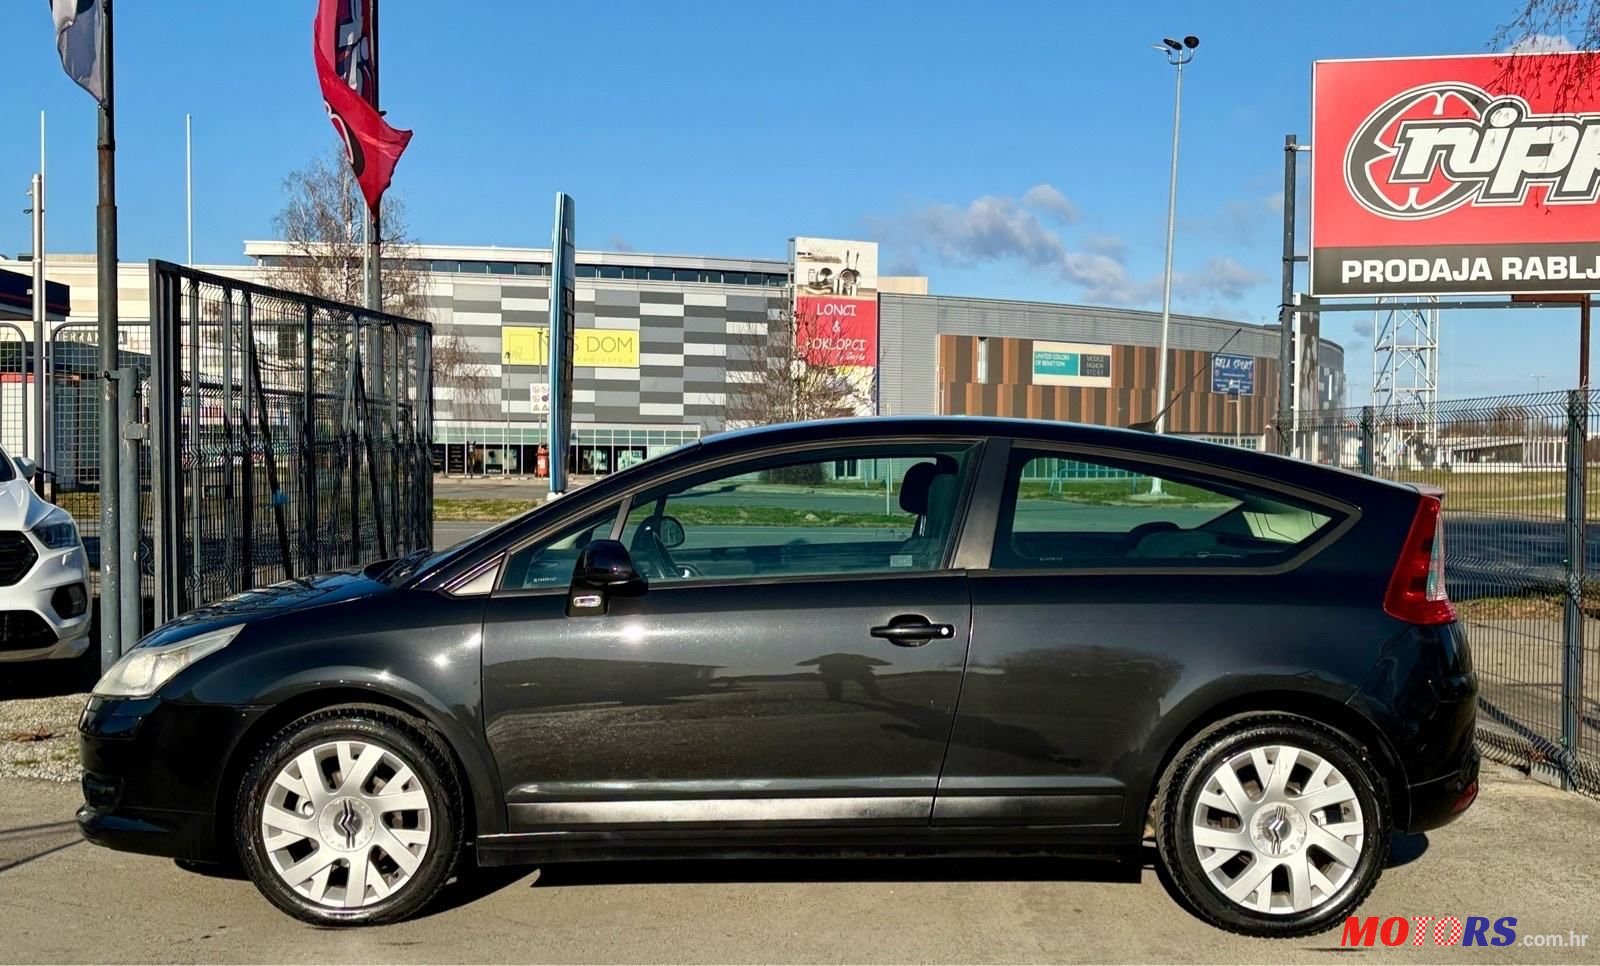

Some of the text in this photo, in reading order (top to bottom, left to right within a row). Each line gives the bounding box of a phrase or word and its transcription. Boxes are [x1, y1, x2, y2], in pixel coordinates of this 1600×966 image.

[1341, 255, 1600, 283] PRODAJA RABLJ
[816, 303, 857, 316] LONCI
[832, 320, 841, 333] &
[586, 336, 633, 353] DOM
